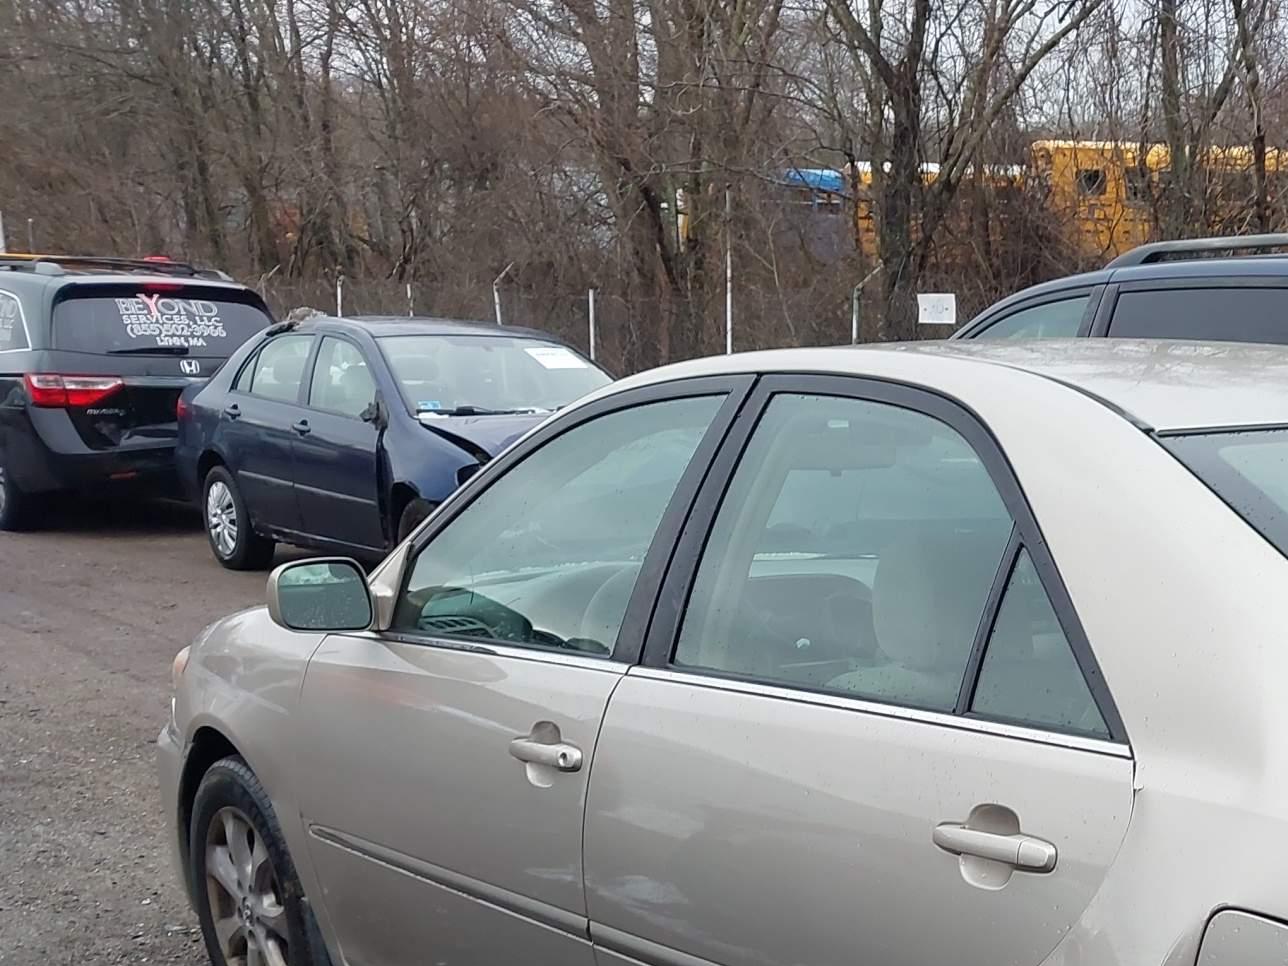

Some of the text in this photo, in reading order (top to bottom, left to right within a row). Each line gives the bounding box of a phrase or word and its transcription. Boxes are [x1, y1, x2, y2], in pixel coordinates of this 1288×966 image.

[115, 293, 218, 318] BEYOND
[122, 315, 223, 326] SERVICES, LLC
